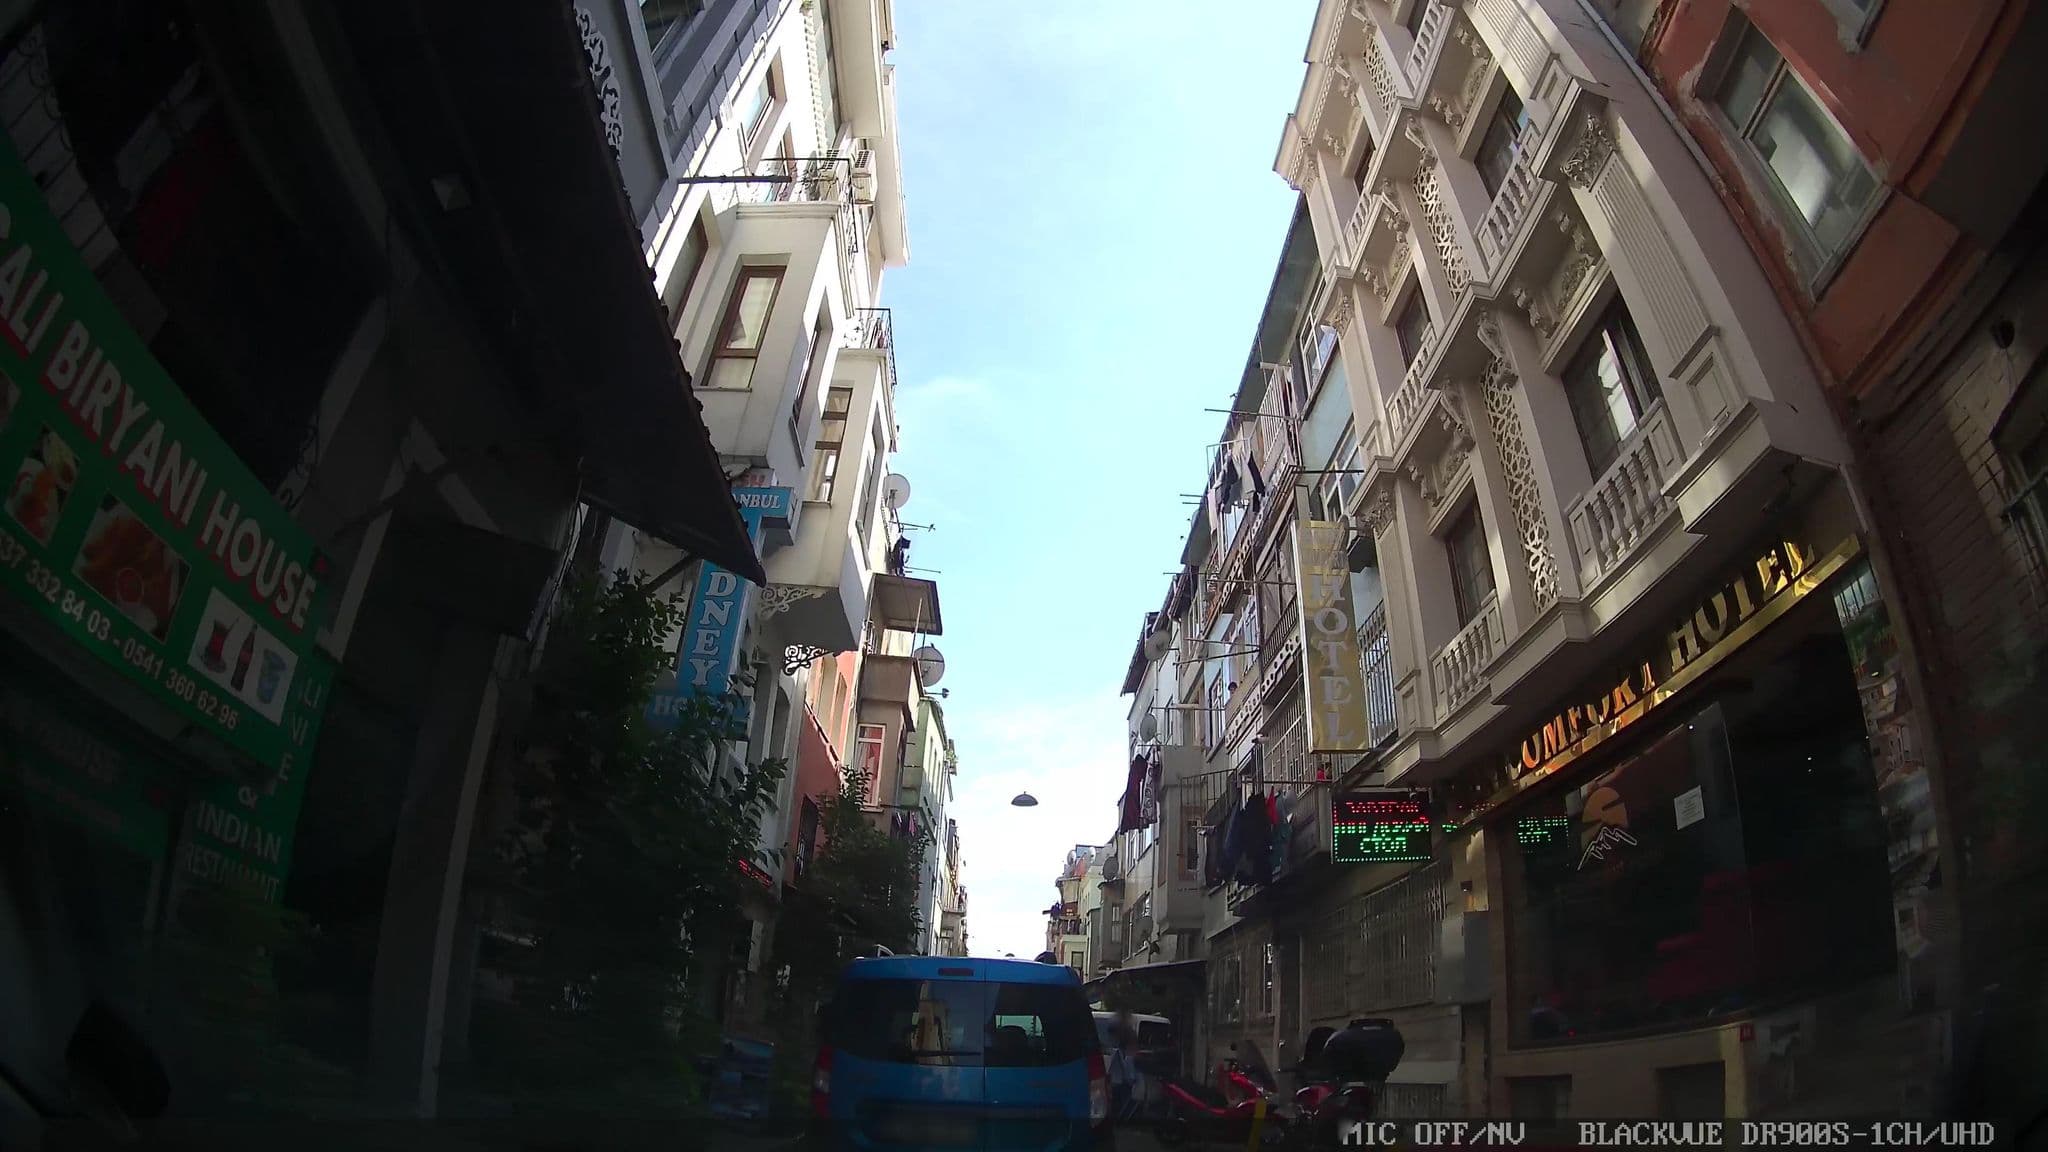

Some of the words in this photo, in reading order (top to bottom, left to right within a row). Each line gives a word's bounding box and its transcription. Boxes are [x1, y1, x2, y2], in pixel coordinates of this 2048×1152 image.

[0, 203, 63, 355] ALI
[46, 319, 208, 525] BIRYANI
[202, 489, 317, 628] HOUSE
[25, 560, 61, 603] 332
[61, 589, 86, 622] 84
[87, 609, 111, 640] 03
[123, 638, 164, 680] 0541
[166, 668, 195, 701] 360
[197, 690, 217, 716] 62
[1311, 572, 1355, 742] HOTEL
[1670, 541, 1815, 673] HOTEL
[197, 800, 282, 864] INDIAN
